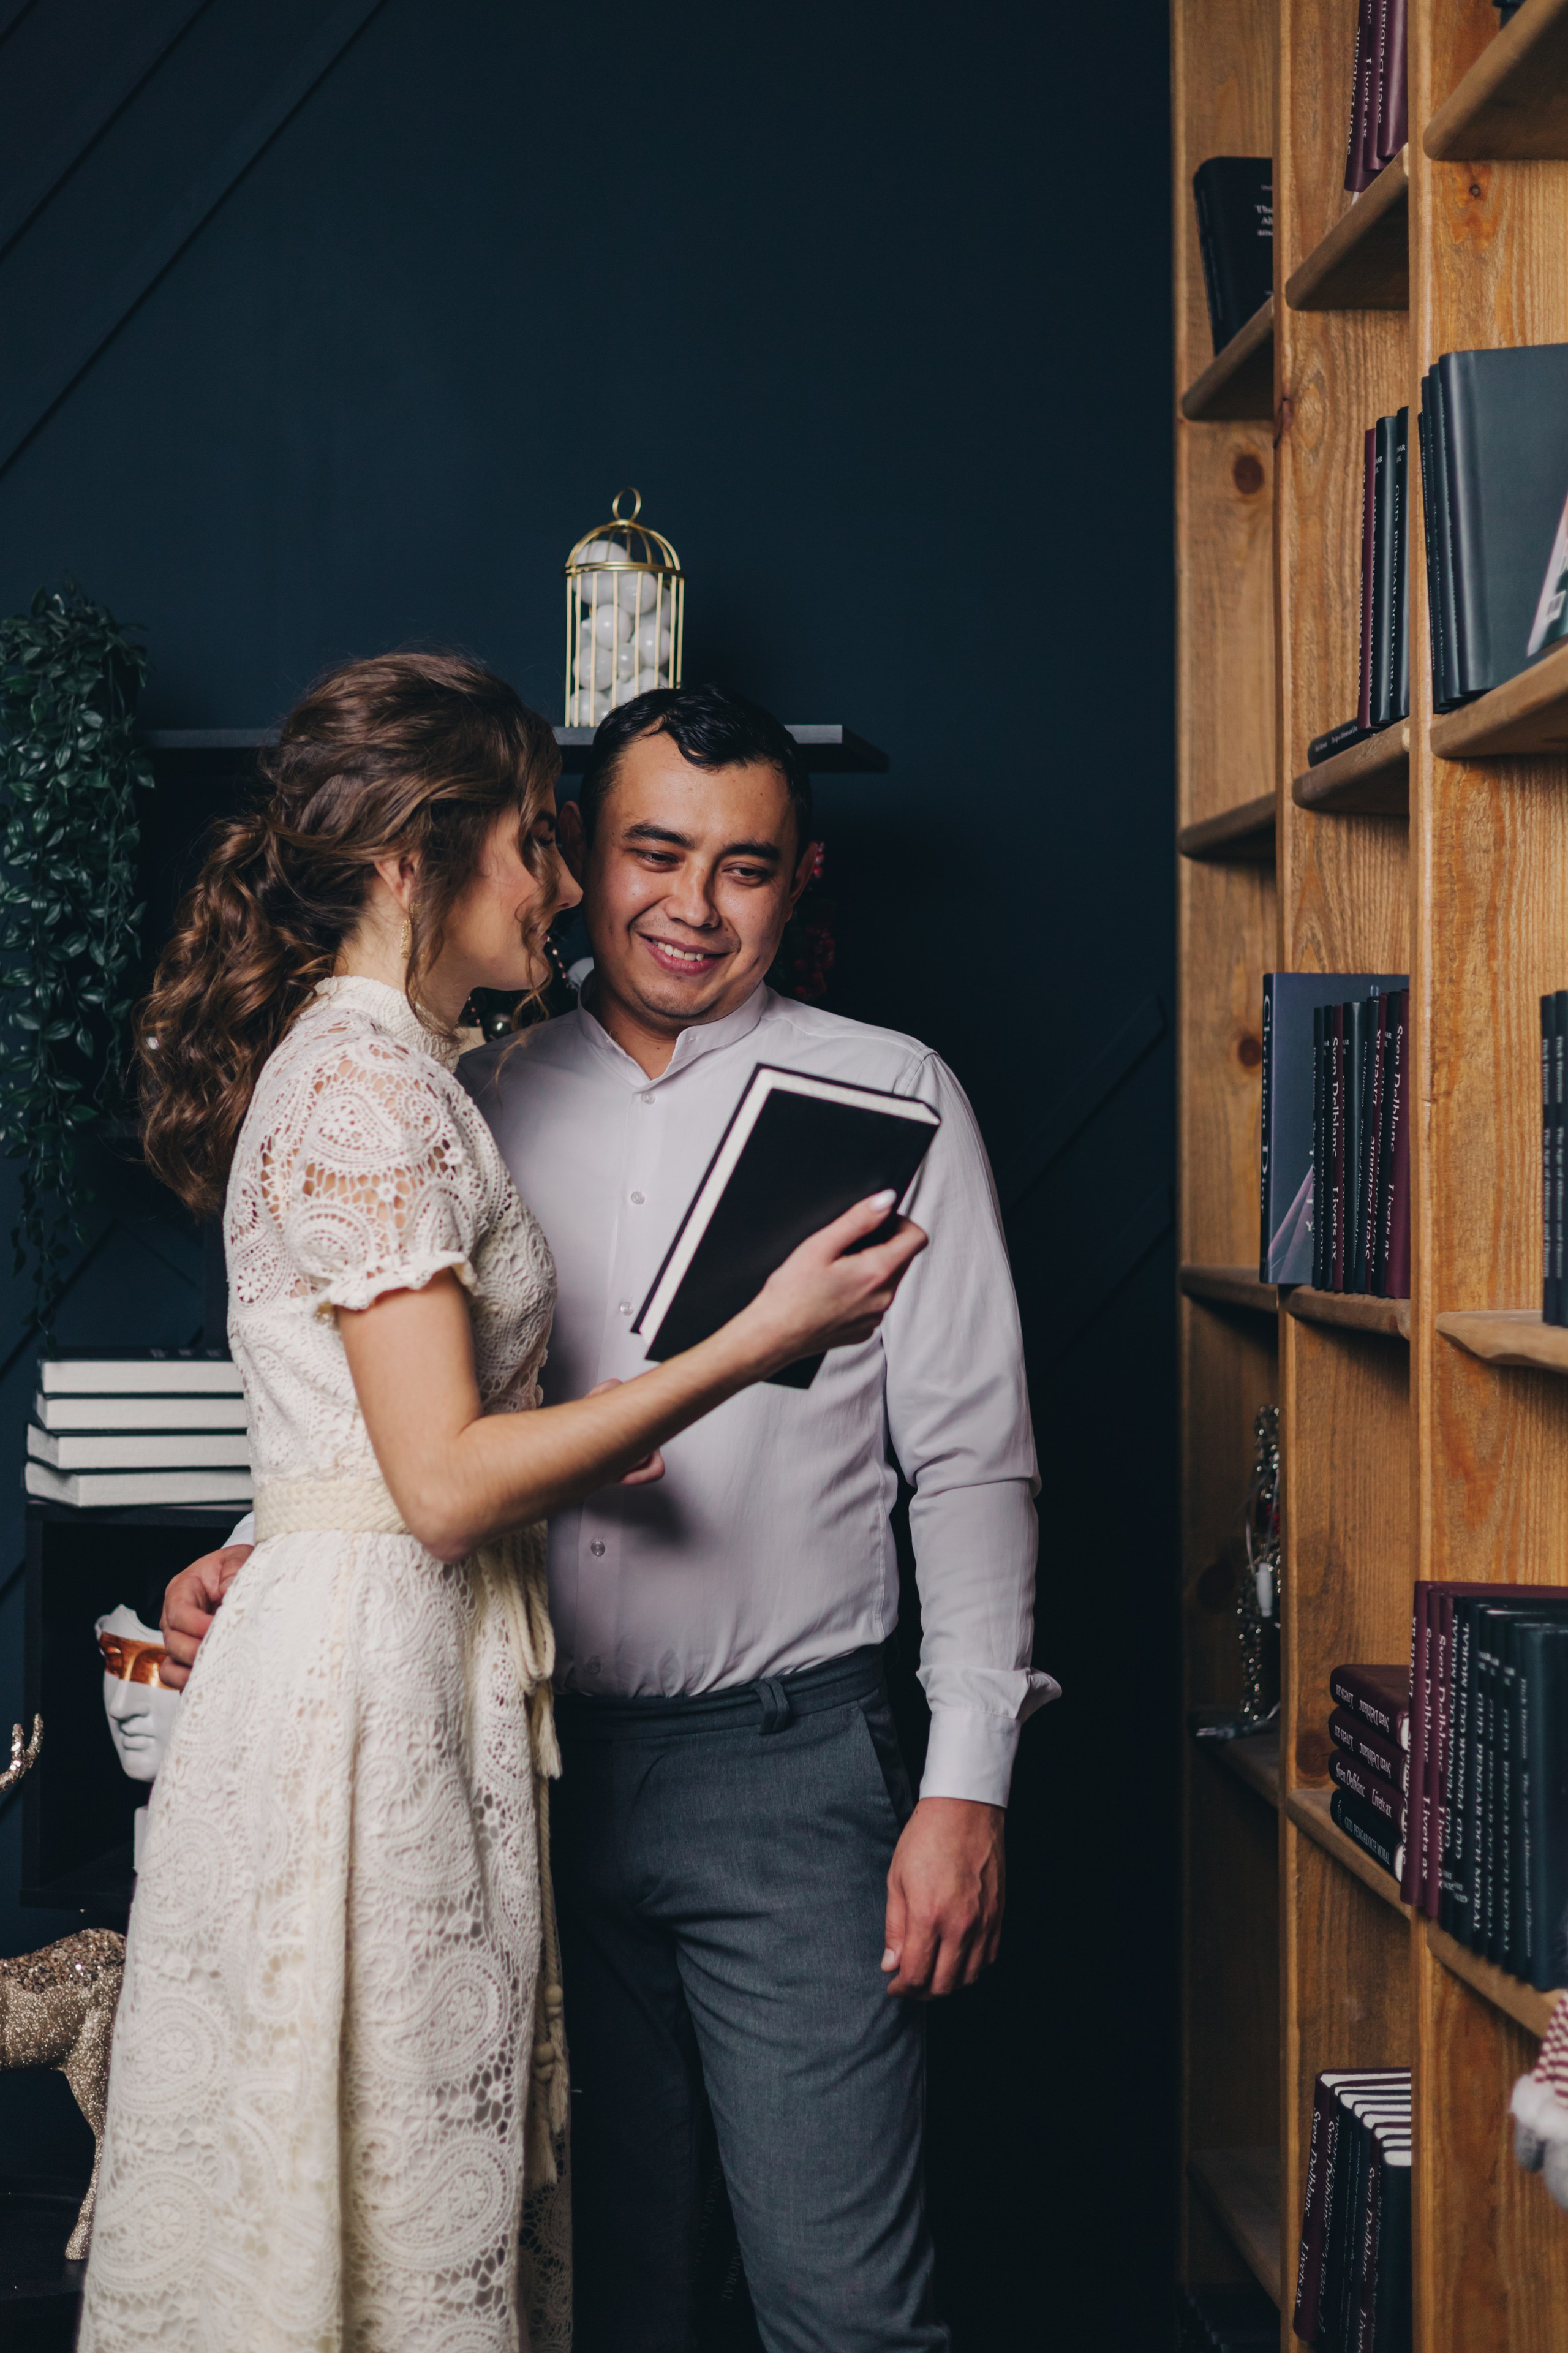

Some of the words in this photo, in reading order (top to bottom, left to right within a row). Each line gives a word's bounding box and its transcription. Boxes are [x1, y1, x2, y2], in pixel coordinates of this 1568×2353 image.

[1262, 994, 1270, 1129] Christian
[1395, 1024, 1403, 1066] Sven
[1390, 1072, 1401, 1152] Delblanc
[1385, 1183, 1395, 1236] Livets
[1332, 1241, 1337, 1261] ax
[1384, 1239, 1389, 1261] ax
[1461, 1622, 1470, 1688] MORAL
[1335, 1683, 1341, 1696] ax
[1341, 1687, 1354, 1709] Livets
[1335, 1724, 1341, 1738] ax
[1359, 1699, 1379, 1726] Delblanc
[1379, 1711, 1390, 1733] Sven
[1340, 1728, 1354, 1752] Livets
[1359, 1742, 1380, 1770] Delblanc
[1379, 1756, 1392, 1779] Sven
[1335, 1762, 1346, 1783] Sven
[1346, 1769, 1366, 1798] Delblanc
[1371, 1788, 1385, 1813] Livets
[1385, 1805, 1392, 1818] ax
[1344, 1816, 1354, 1833] GUD
[1422, 1797, 1431, 1853] Livets
[1422, 1857, 1428, 1881] ax
[1473, 1867, 1482, 1932] MORAL
[1312, 2108, 1321, 2144] Sven
[1326, 2118, 1335, 2155] Sven
[1305, 2148, 1317, 2217] Delblanc
[1323, 2159, 1333, 2228] Delblanc
[1366, 2165, 1376, 2204] Sven
[1362, 2207, 1373, 2282] Delblanc
[1298, 2241, 1309, 2286] Livets
[1296, 2287, 1303, 2308] ax
[1357, 2308, 1367, 2353] Livet
